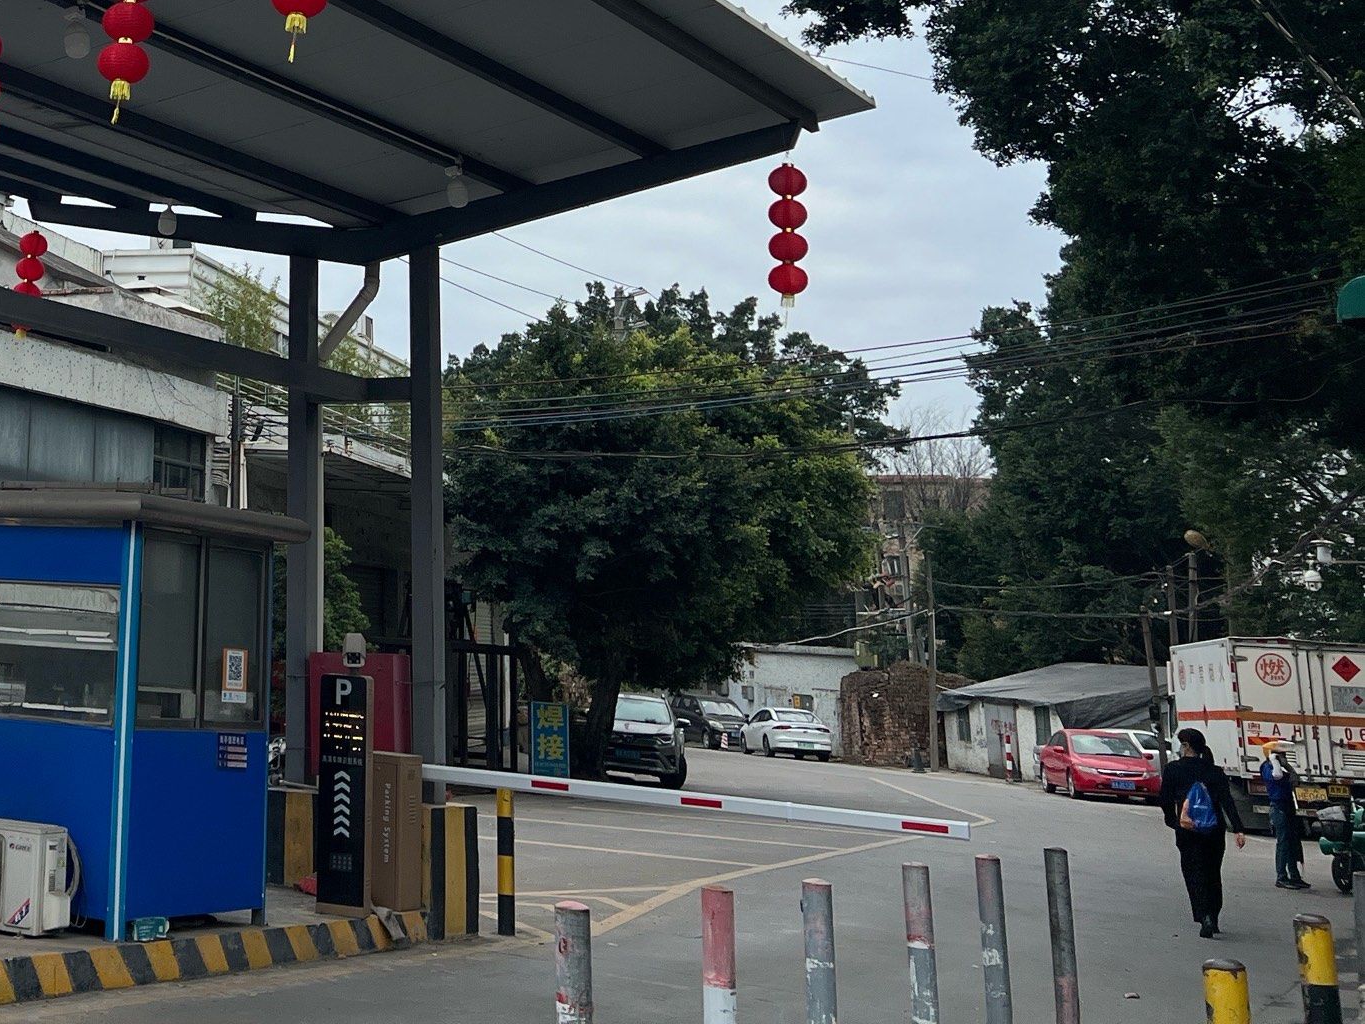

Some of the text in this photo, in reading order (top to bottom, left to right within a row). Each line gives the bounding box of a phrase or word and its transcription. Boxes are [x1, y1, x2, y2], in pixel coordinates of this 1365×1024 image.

[1259, 657, 1287, 682] 燃
[335, 678, 353, 705] P
[537, 704, 565, 760] 焊接
[382, 782, 392, 863] Parking System
